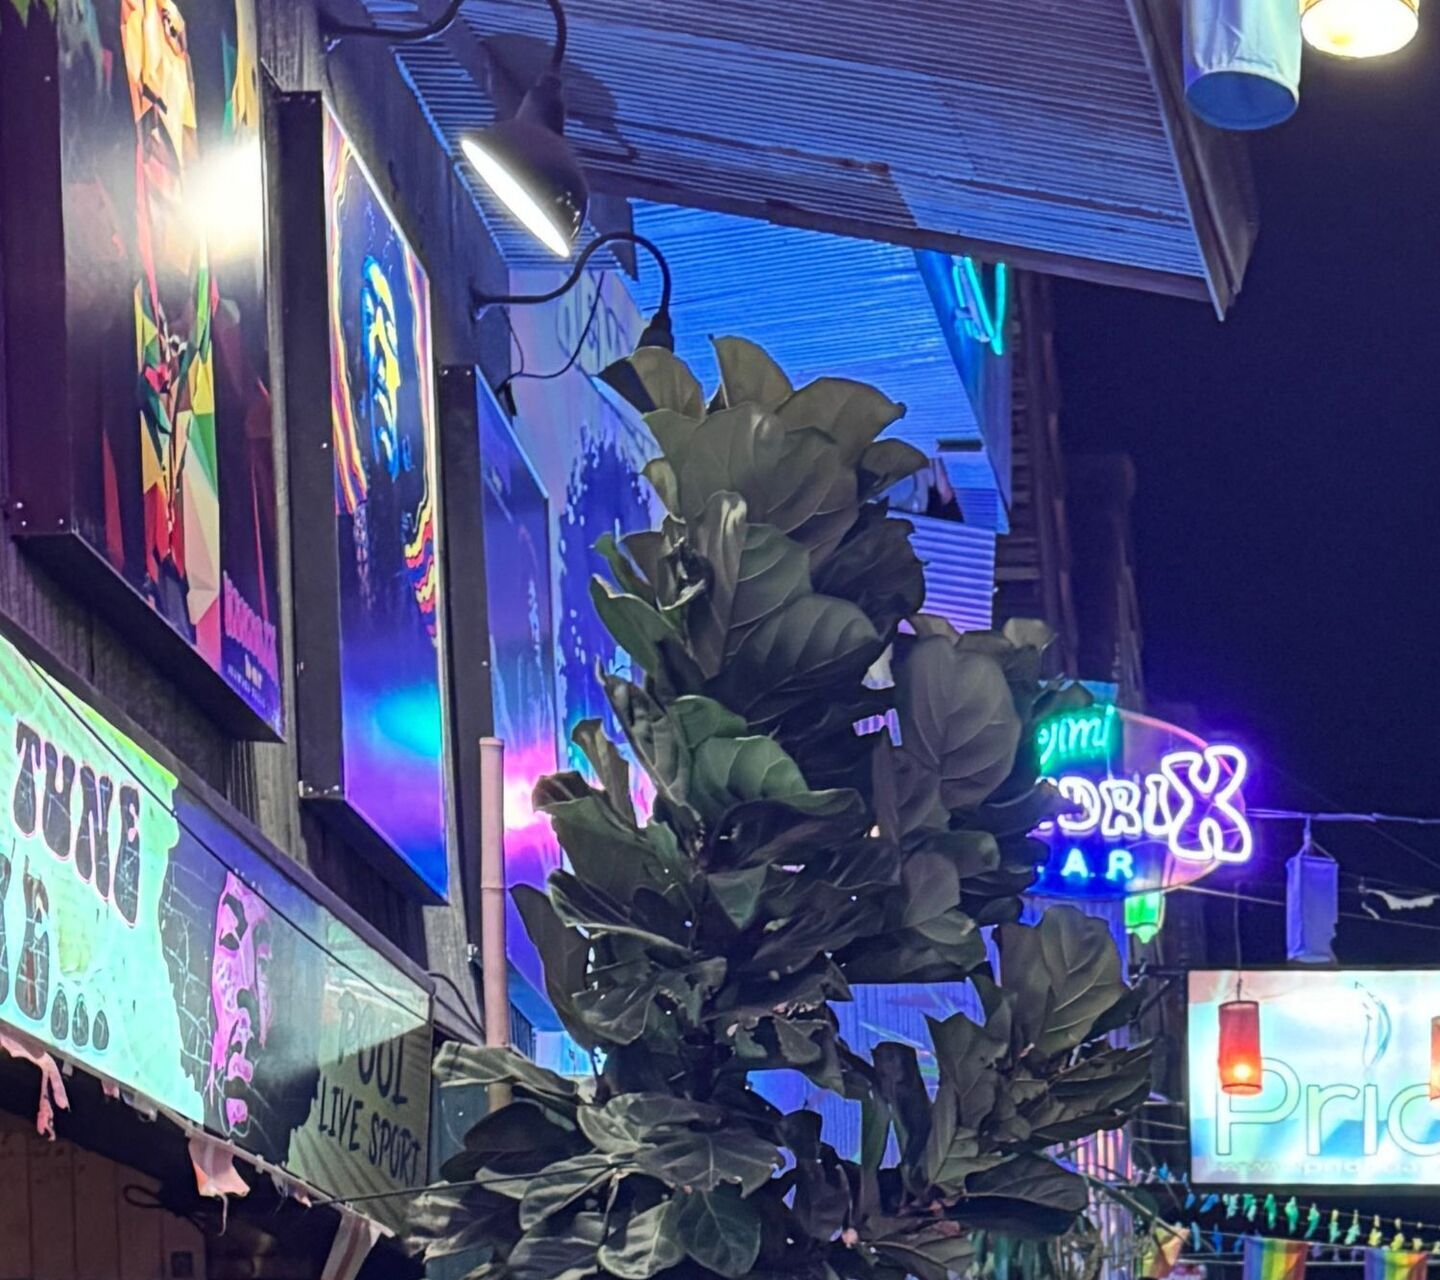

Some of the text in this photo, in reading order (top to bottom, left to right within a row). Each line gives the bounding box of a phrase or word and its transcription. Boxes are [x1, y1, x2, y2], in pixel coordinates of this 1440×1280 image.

[14, 721, 140, 928] TUNE
[1036, 745, 1252, 862] DRIX
[318, 1076, 364, 1151] LIVE
